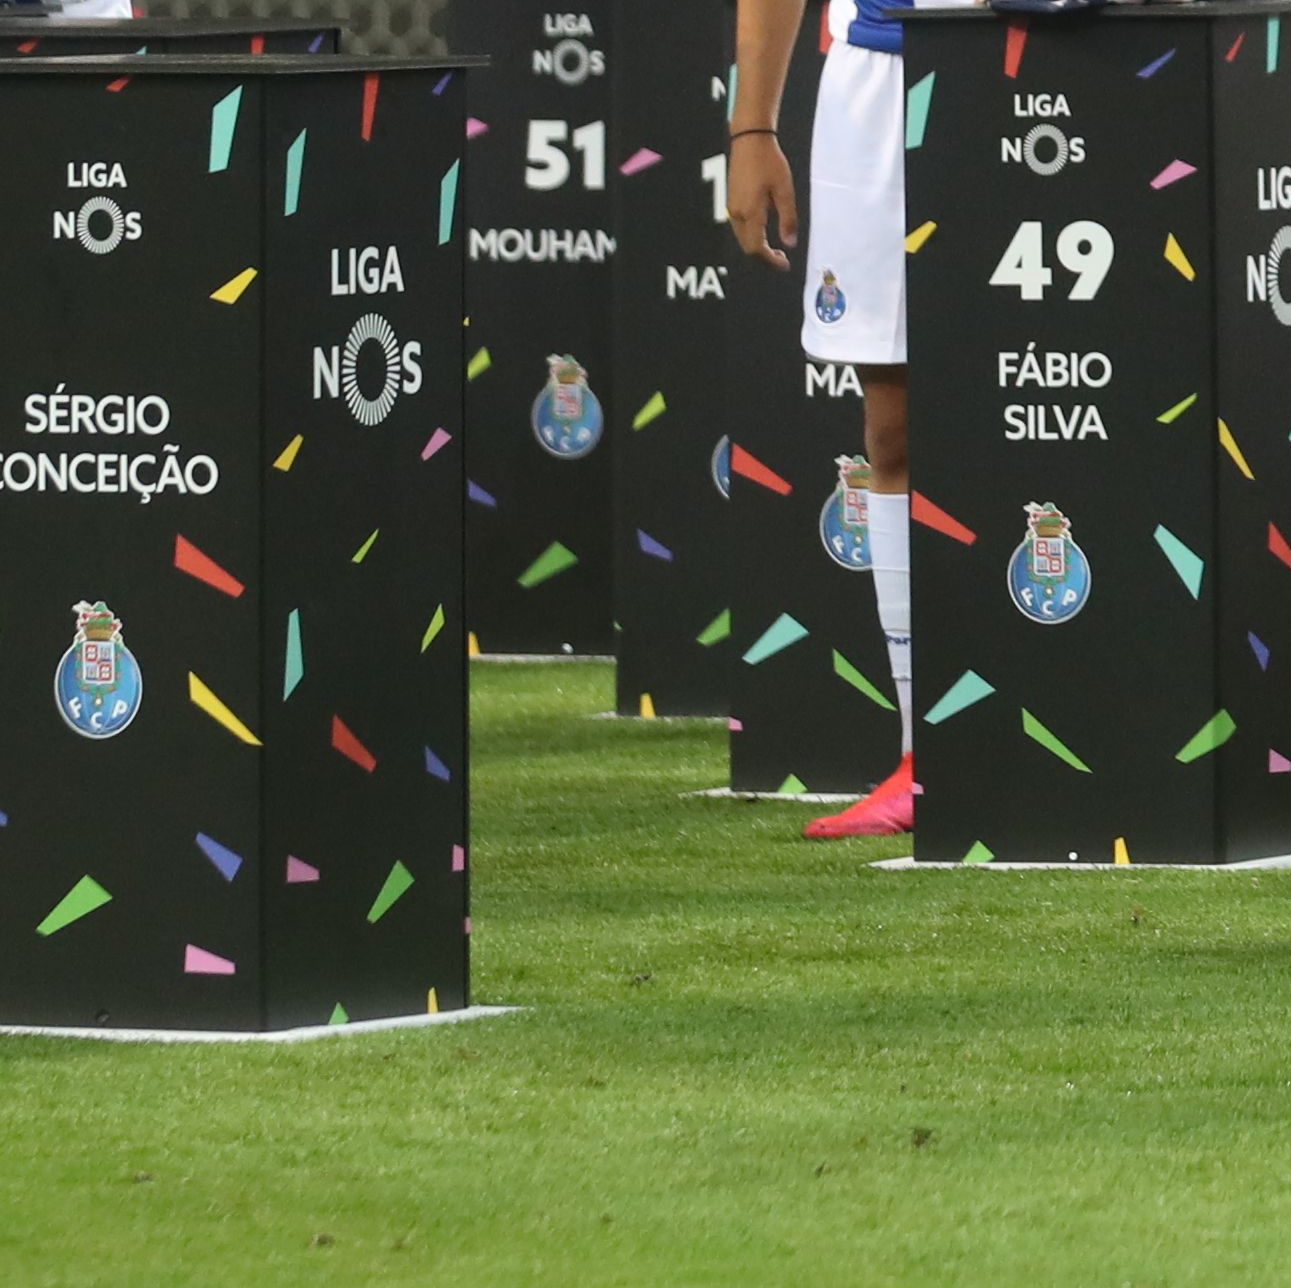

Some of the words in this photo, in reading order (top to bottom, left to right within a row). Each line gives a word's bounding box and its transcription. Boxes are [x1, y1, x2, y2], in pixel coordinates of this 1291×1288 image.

[545, 14, 593, 36] LIGA
[533, 40, 604, 83] NOS
[1015, 94, 1071, 117] LIGA
[525, 120, 605, 190] 51
[1001, 124, 1085, 175] NOS
[68, 163, 127, 187] LIGA
[54, 196, 142, 254] NOS
[332, 246, 404, 295] LIGA
[667, 266, 727, 299] MA
[989, 221, 1114, 300] 49
[314, 313, 422, 426] NOS
[806, 363, 864, 398] MA
[999, 342, 1112, 387] FÁBIO
[25, 383, 169, 435] SÉRGIO
[1004, 405, 1108, 440] SILVA
[0, 444, 218, 504] ONCEIÇÃO
